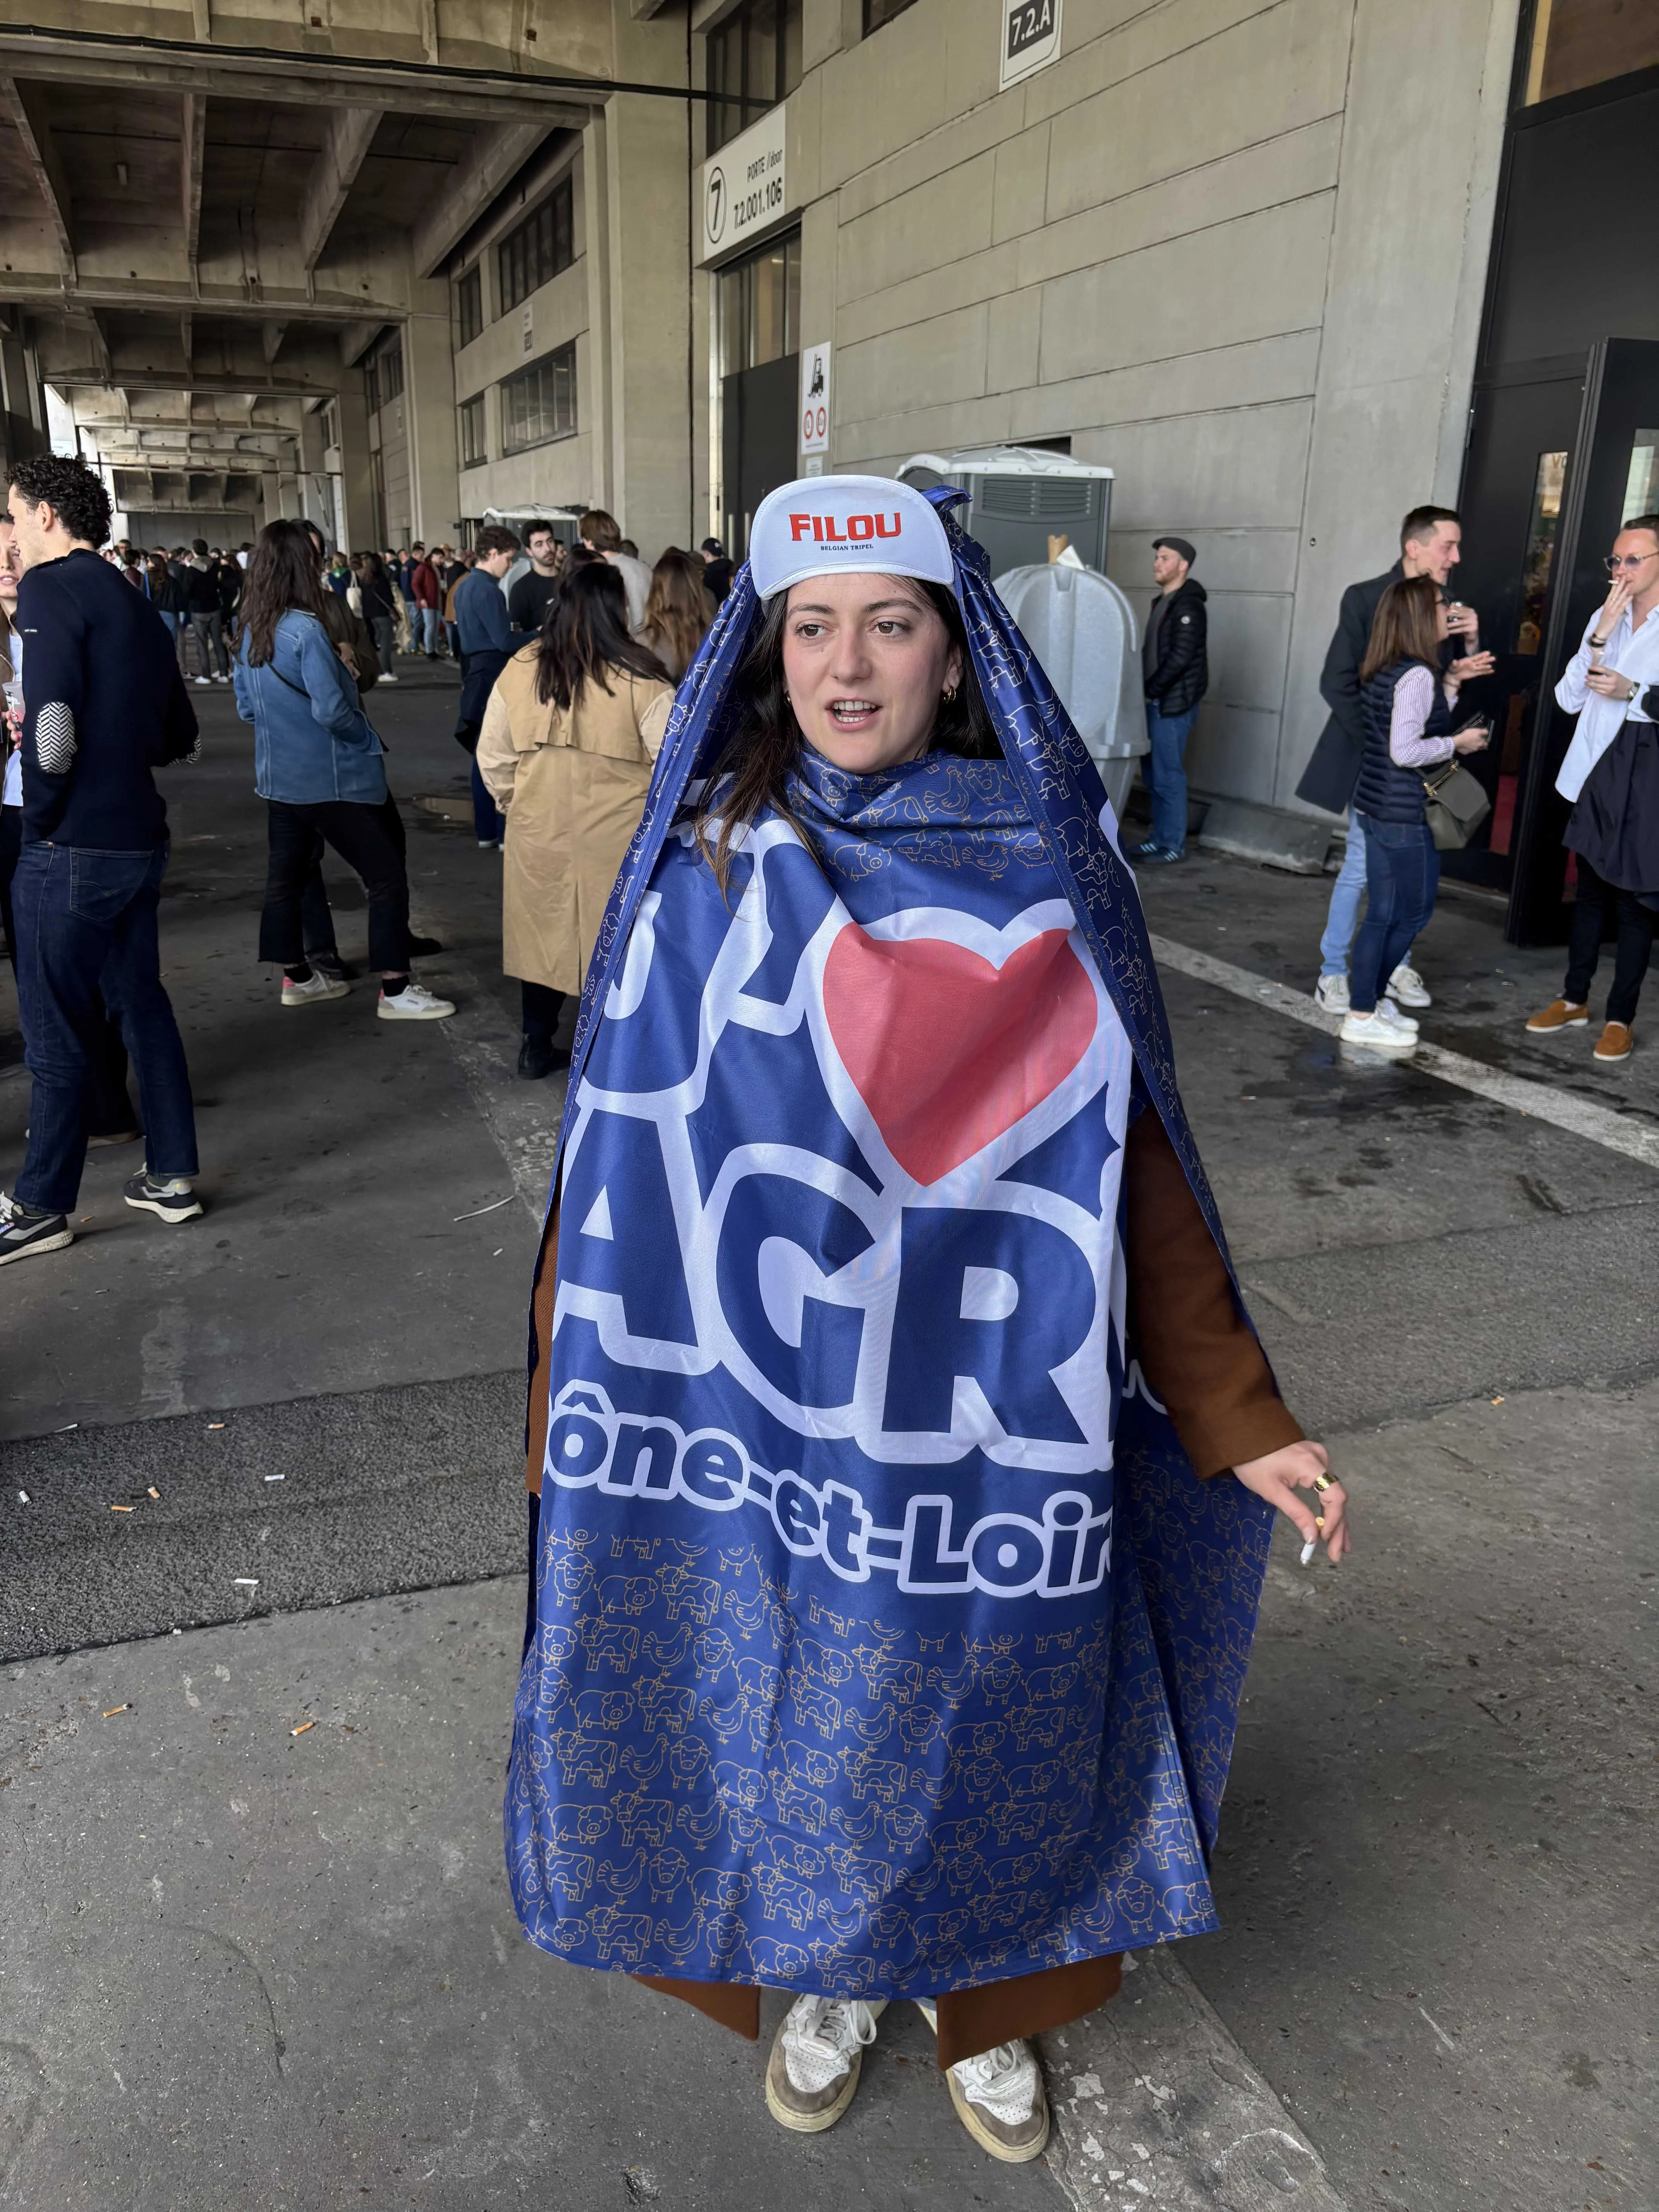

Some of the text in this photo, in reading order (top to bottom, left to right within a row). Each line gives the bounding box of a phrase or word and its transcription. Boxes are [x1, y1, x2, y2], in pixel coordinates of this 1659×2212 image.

[1012, 0, 1051, 46] 7.2.A
[747, 156, 765, 183] PORTE
[711, 179, 721, 231] 7
[733, 177, 782, 229] 7.2.001.106
[789, 512, 902, 541] FILOU
[555, 1107, 1111, 1445] AGR
[547, 1388, 1111, 1589] ône-et-Loir
